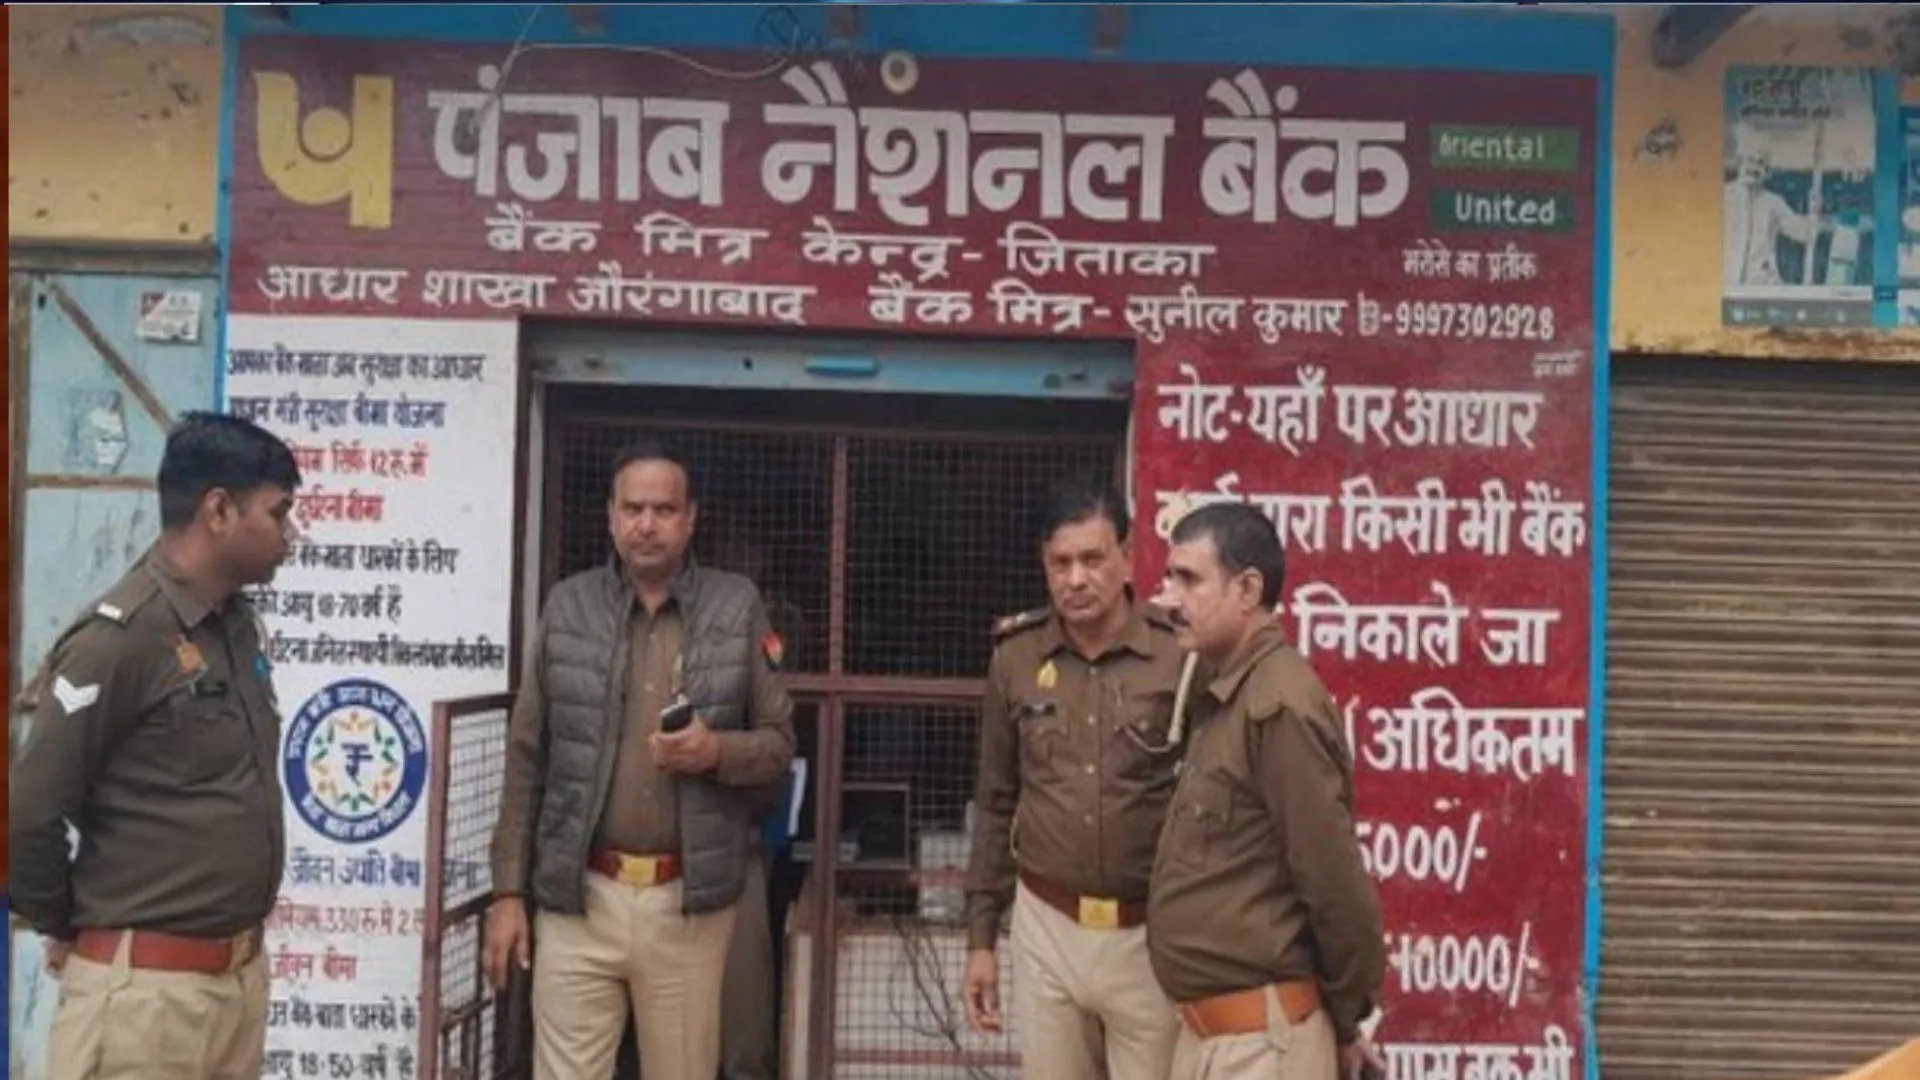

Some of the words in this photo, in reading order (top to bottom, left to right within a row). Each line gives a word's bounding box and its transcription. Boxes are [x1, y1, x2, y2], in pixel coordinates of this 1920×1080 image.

[428, 64, 729, 206] पंजाब
[761, 61, 1175, 226] नैशनल
[1201, 69, 1409, 228] बैंक
[484, 203, 601, 252] बैंक
[635, 209, 769, 264] मित्र
[998, 221, 1217, 276] जिताका
[1454, 192, 1555, 225] United
[256, 264, 409, 304] आधार
[423, 268, 556, 309] शाखा
[567, 260, 817, 325] औरंगाबाद
[868, 271, 974, 324] बैंक
[1124, 283, 1246, 344] सुनील
[1251, 296, 1348, 344] कुमार
[1339, 474, 1457, 556] किसी
[1458, 476, 1516, 556] भी
[1520, 480, 1586, 556] बैंक
[1290, 581, 1468, 667] निकाले
[1479, 608, 1561, 667] जा
